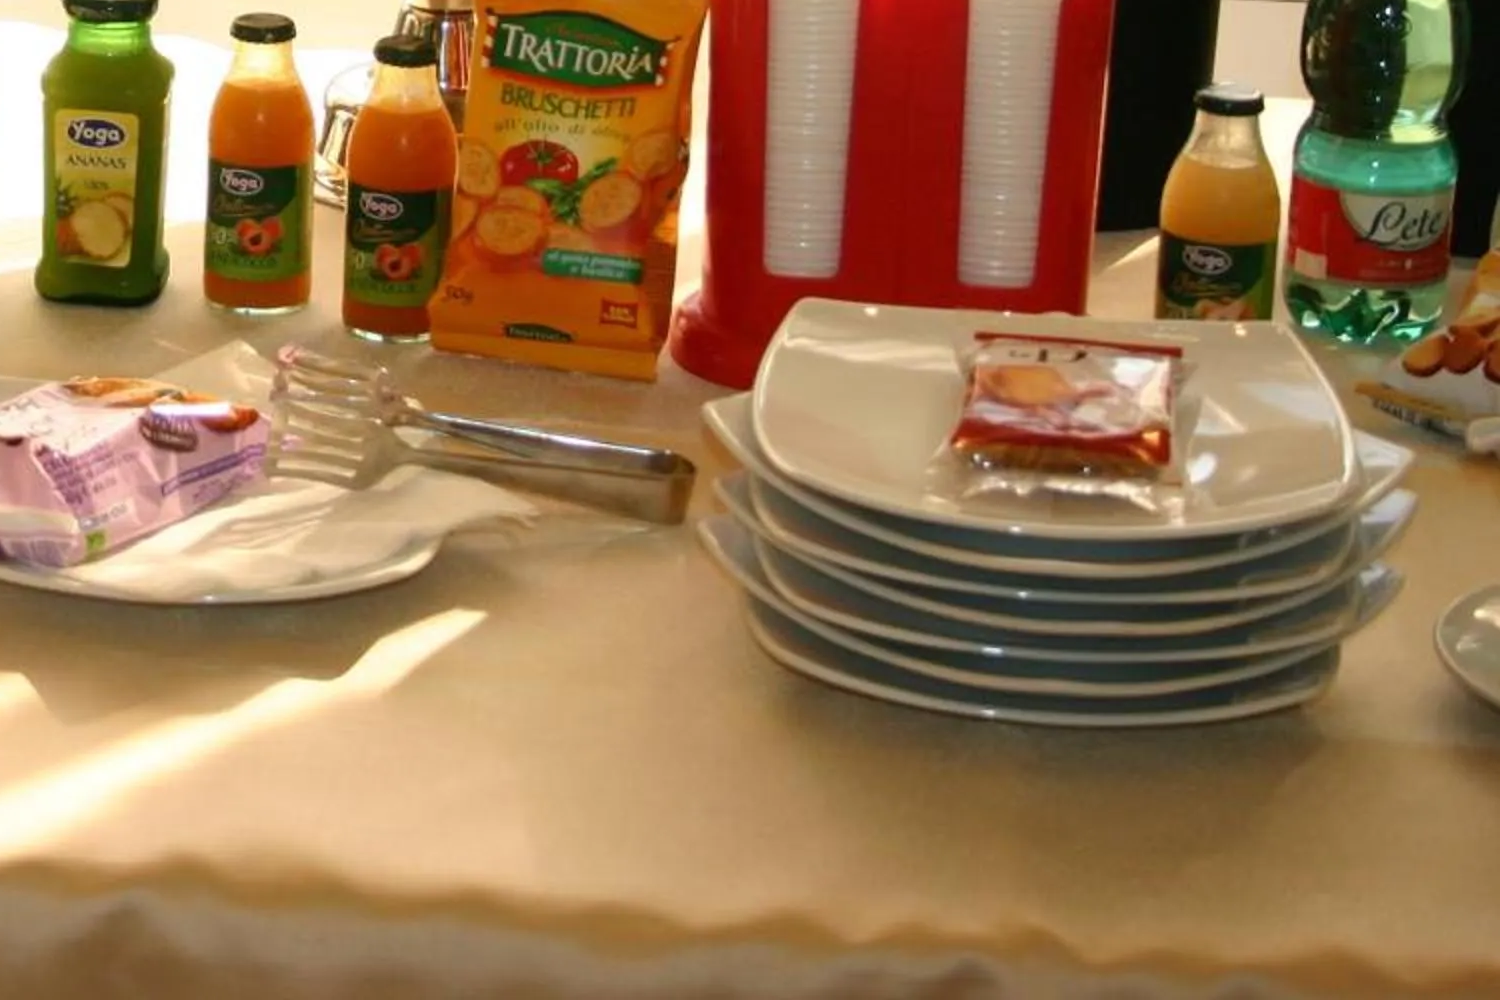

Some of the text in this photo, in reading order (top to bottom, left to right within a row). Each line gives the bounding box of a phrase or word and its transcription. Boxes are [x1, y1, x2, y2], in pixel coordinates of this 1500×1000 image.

[501, 82, 636, 120] BRUSCHETTI
[72, 121, 121, 146] Yoga
[65, 153, 127, 170] ANANAS
[1364, 201, 1443, 246] Lete
